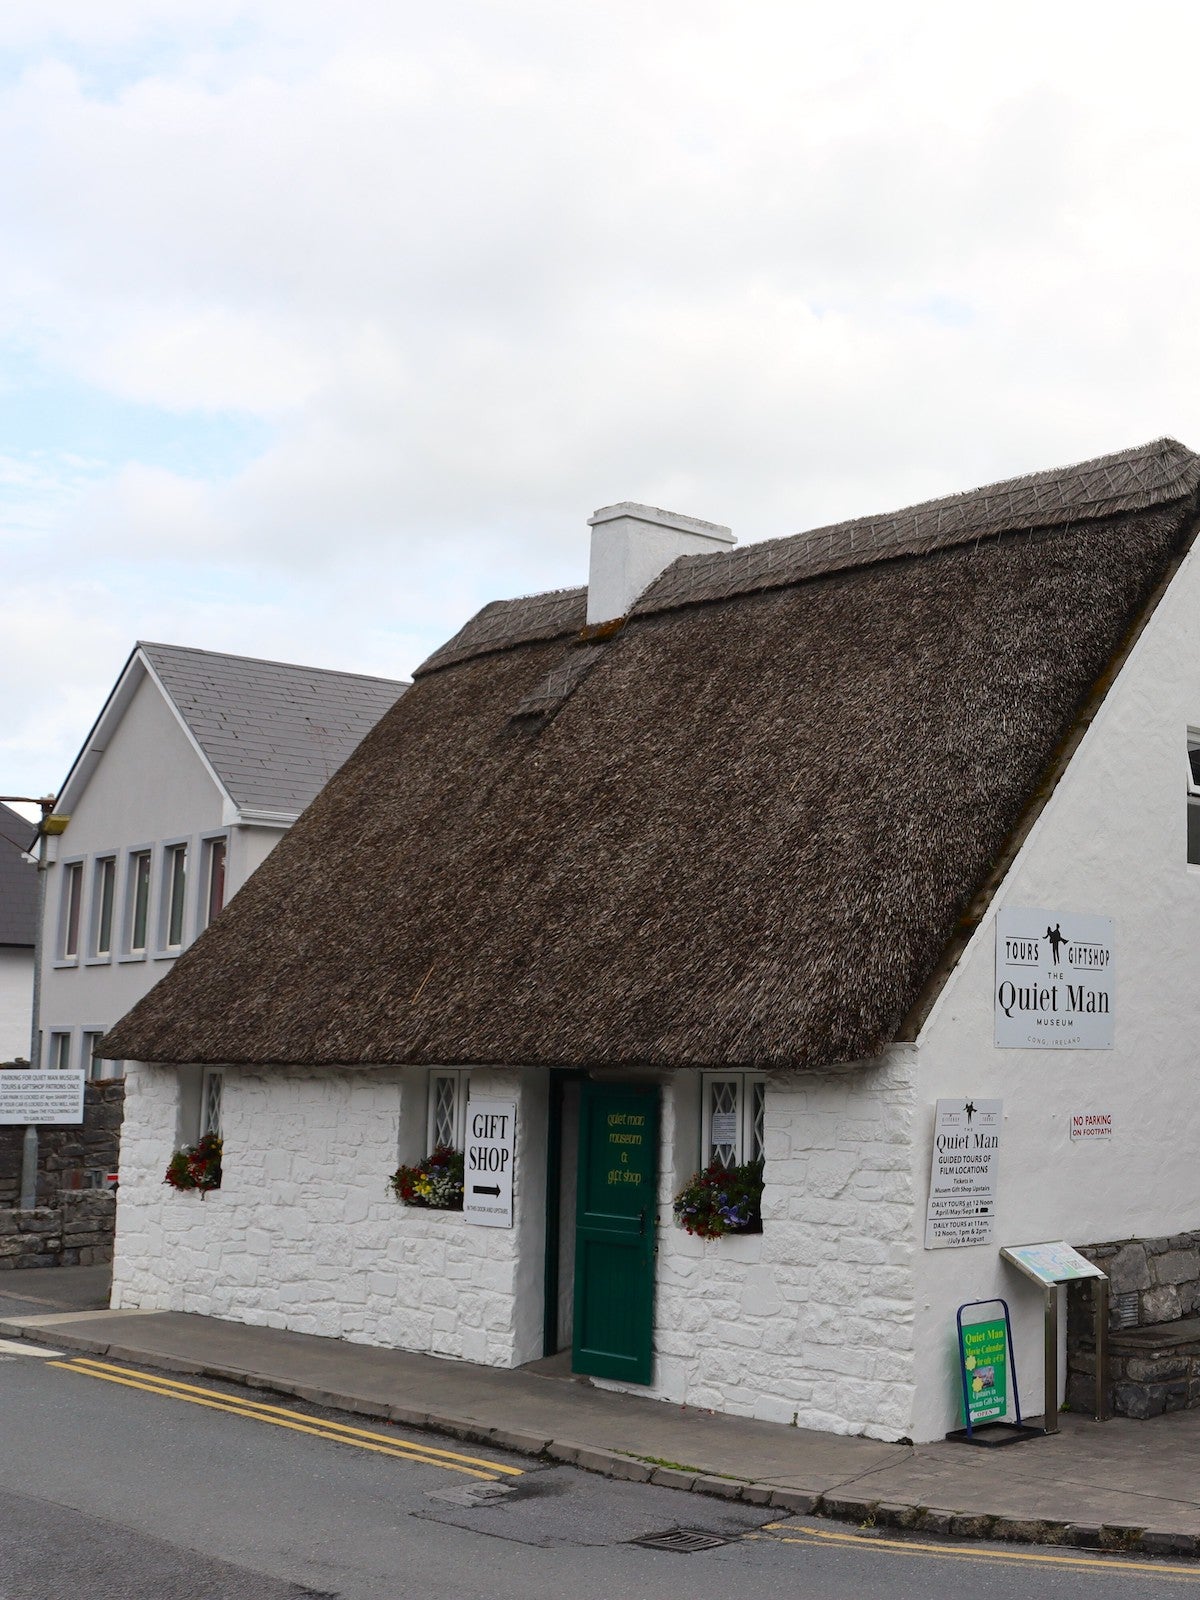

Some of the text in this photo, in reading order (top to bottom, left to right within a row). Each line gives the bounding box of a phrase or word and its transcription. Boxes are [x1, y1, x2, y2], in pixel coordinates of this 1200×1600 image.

[1005, 941, 1110, 966] TOURS GIFTSHOP
[1047, 972, 1064, 980] THE
[998, 980, 1110, 1018] Quiet Man
[1051, 1036, 1081, 1046] IRELAND
[472, 1114, 508, 1139] GIFT
[1073, 1114, 1112, 1126] NO PARKING
[1082, 1128, 1112, 1136] FOOTPATH
[936, 1133, 999, 1154] Quiet Man
[468, 1146, 509, 1172] SHOP
[938, 1154, 992, 1164] GUIDED TOURS OF
[940, 1166, 988, 1175] FILM LOCATIONS
[965, 1330, 1004, 1346] Quiet Man
